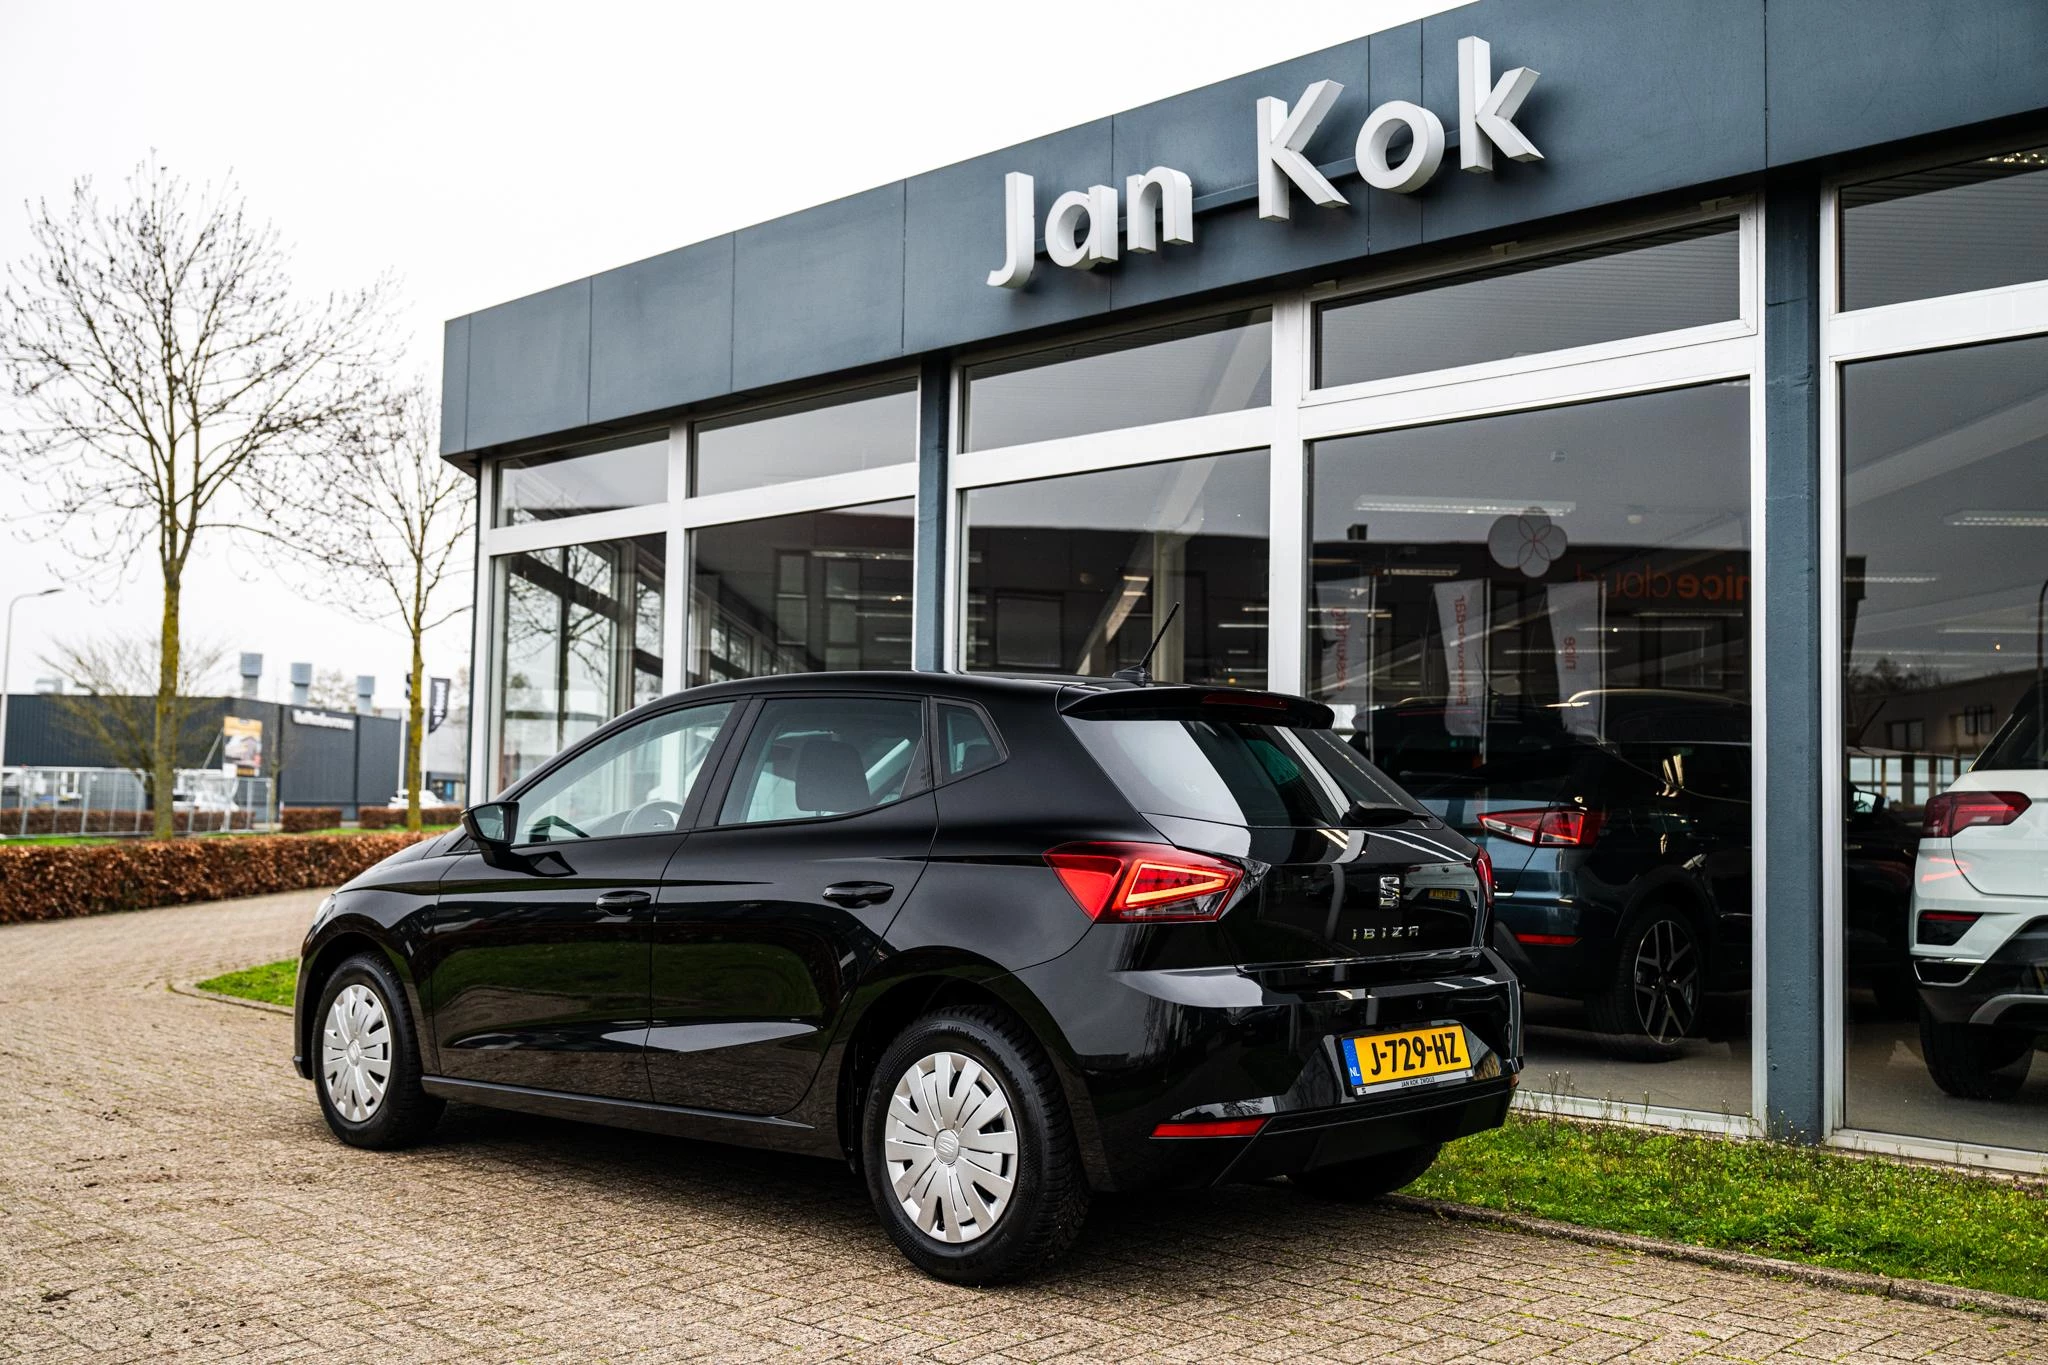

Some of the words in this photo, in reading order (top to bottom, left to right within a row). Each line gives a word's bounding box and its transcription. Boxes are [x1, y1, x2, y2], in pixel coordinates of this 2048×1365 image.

[987, 166, 1193, 289] Jan
[1256, 35, 1544, 222] Kok
[1352, 925, 1419, 940] IBIZA
[1371, 1032, 1461, 1076] J-729-HZ
[1350, 1066, 1360, 1077] NL
